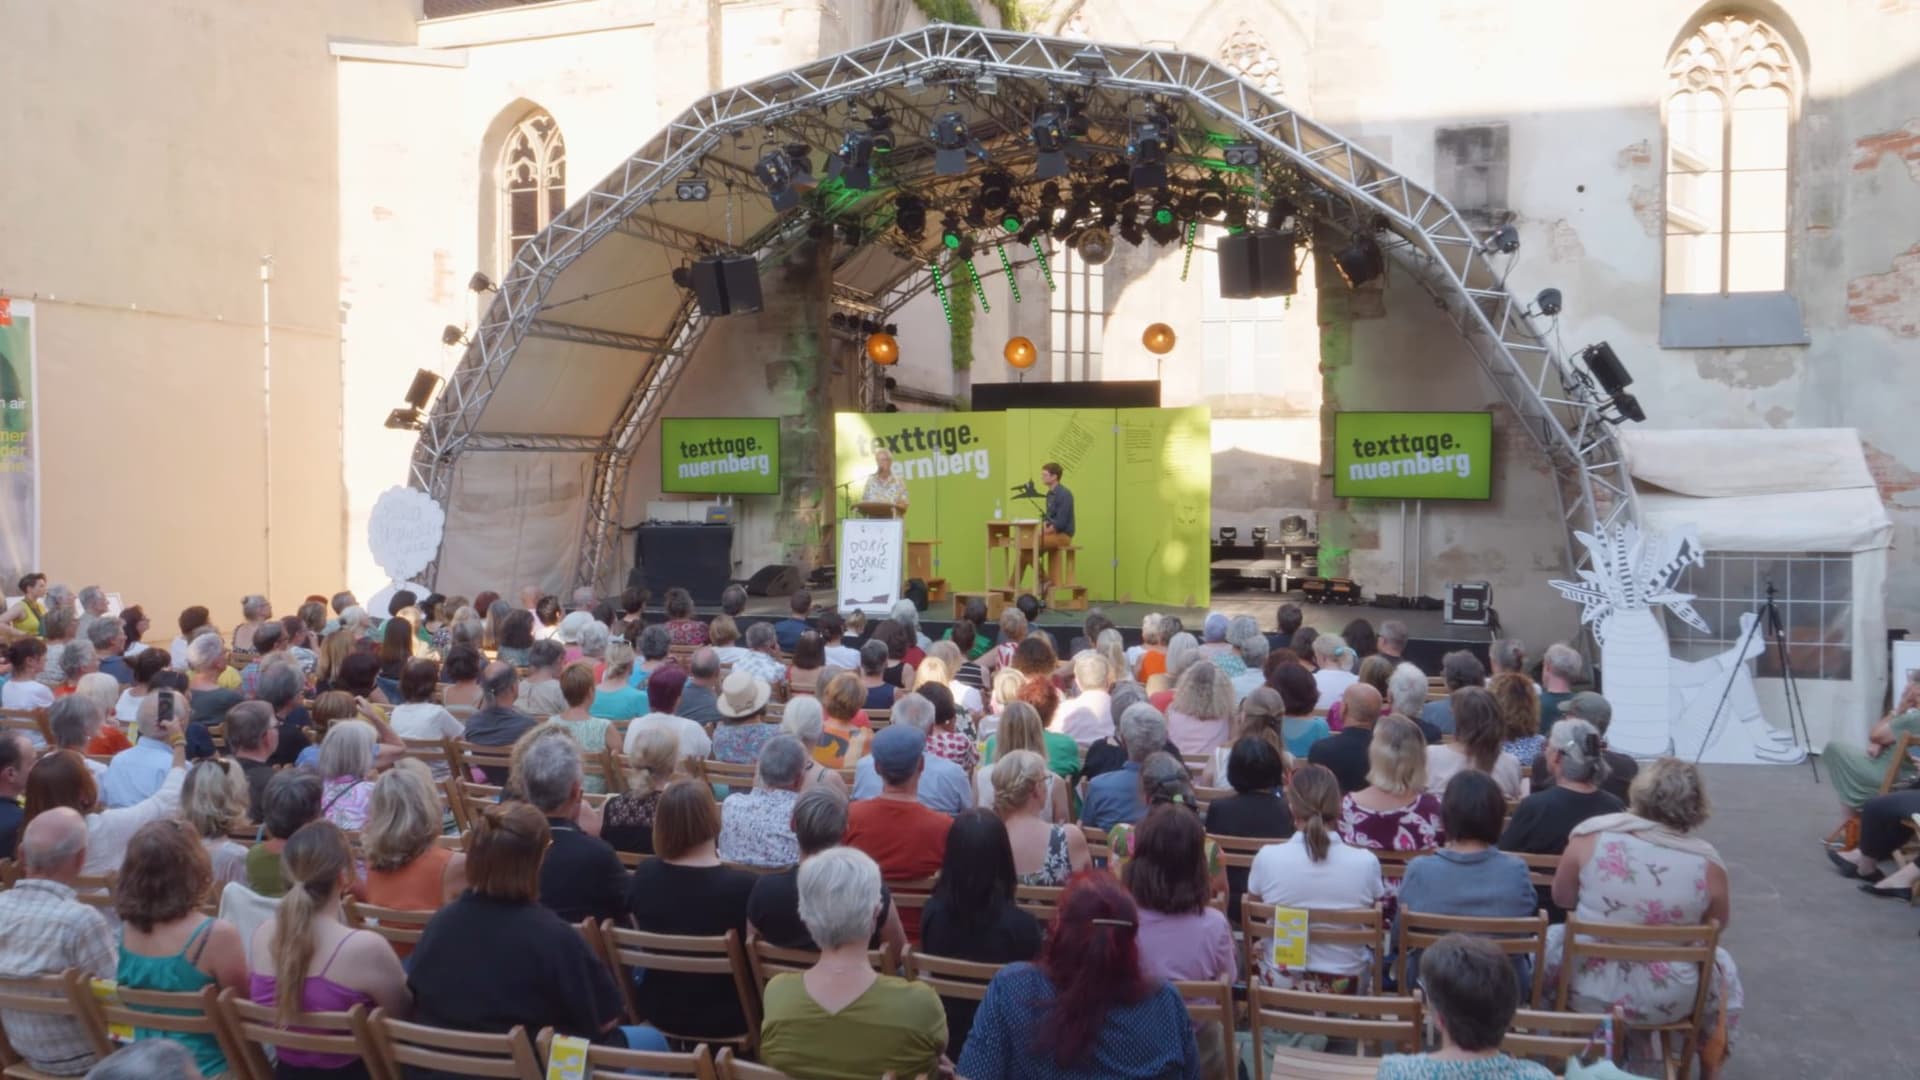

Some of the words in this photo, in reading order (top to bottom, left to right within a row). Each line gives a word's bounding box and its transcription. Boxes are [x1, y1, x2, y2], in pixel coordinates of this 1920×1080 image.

[680, 436, 763, 458] texttage.
[856, 424, 979, 455] texttage.
[1353, 433, 1461, 457] texttage.
[679, 453, 769, 479] nuernberg
[891, 446, 990, 479] ernberg
[1350, 452, 1471, 480] nuernberg
